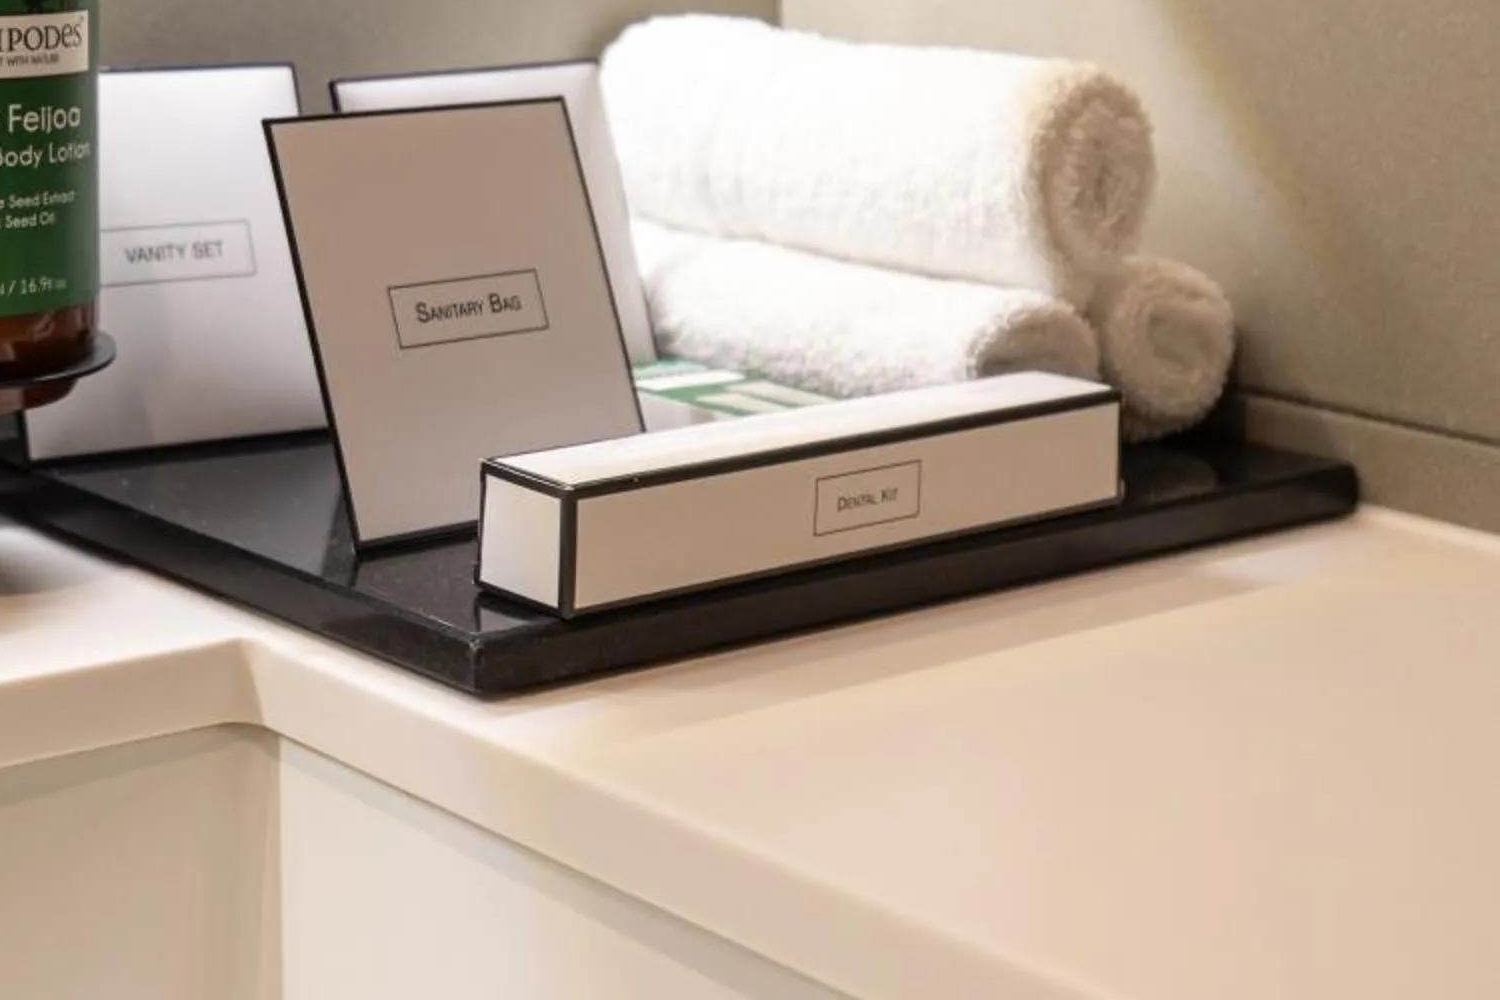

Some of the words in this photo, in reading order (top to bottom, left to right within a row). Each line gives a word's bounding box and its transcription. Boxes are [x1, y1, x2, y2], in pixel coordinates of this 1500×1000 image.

[6, 55, 29, 67] WITH
[8, 103, 81, 135] Feijoa
[49, 141, 92, 164] Lotion
[8, 192, 41, 209] Seed
[5, 212, 37, 229] Seed
[125, 242, 187, 264] VANITY
[192, 239, 225, 260] SET
[415, 299, 483, 324] SANITARY
[487, 291, 522, 315] BAG
[837, 494, 878, 512] DENTAL
